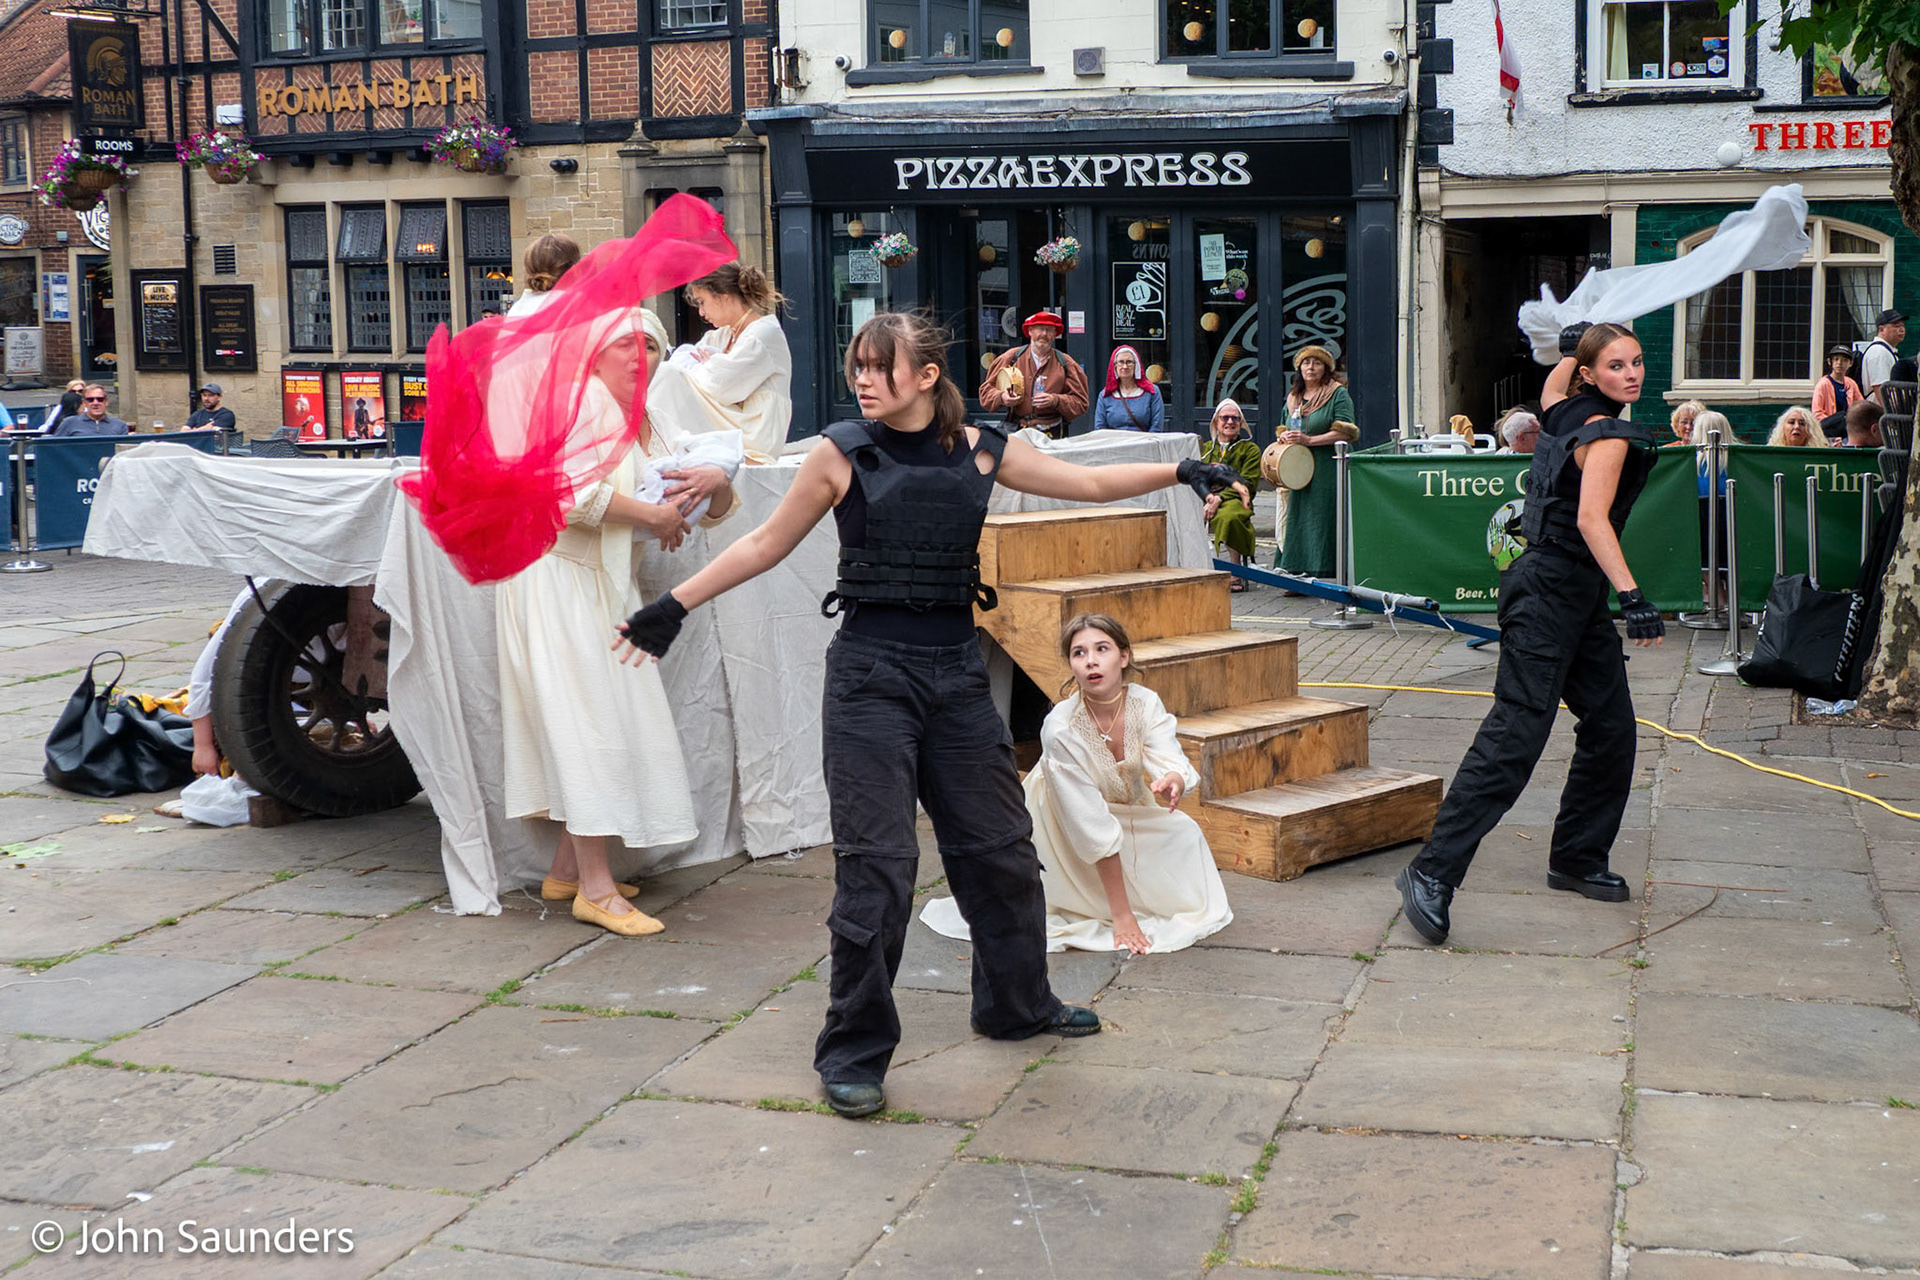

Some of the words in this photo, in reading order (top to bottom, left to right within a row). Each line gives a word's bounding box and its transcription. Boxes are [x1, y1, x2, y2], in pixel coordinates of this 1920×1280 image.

[82, 85, 136, 105] ROMAN
[258, 79, 379, 117] ROMAN
[392, 73, 478, 109] BATH
[94, 103, 127, 116] BATH
[95, 140, 134, 151] ROOMS
[1749, 120, 1892, 150] THREE
[894, 151, 1252, 190] PIZZAEXPRESS
[1417, 469, 1505, 497] Three
[1455, 587, 1487, 600] Beer,
